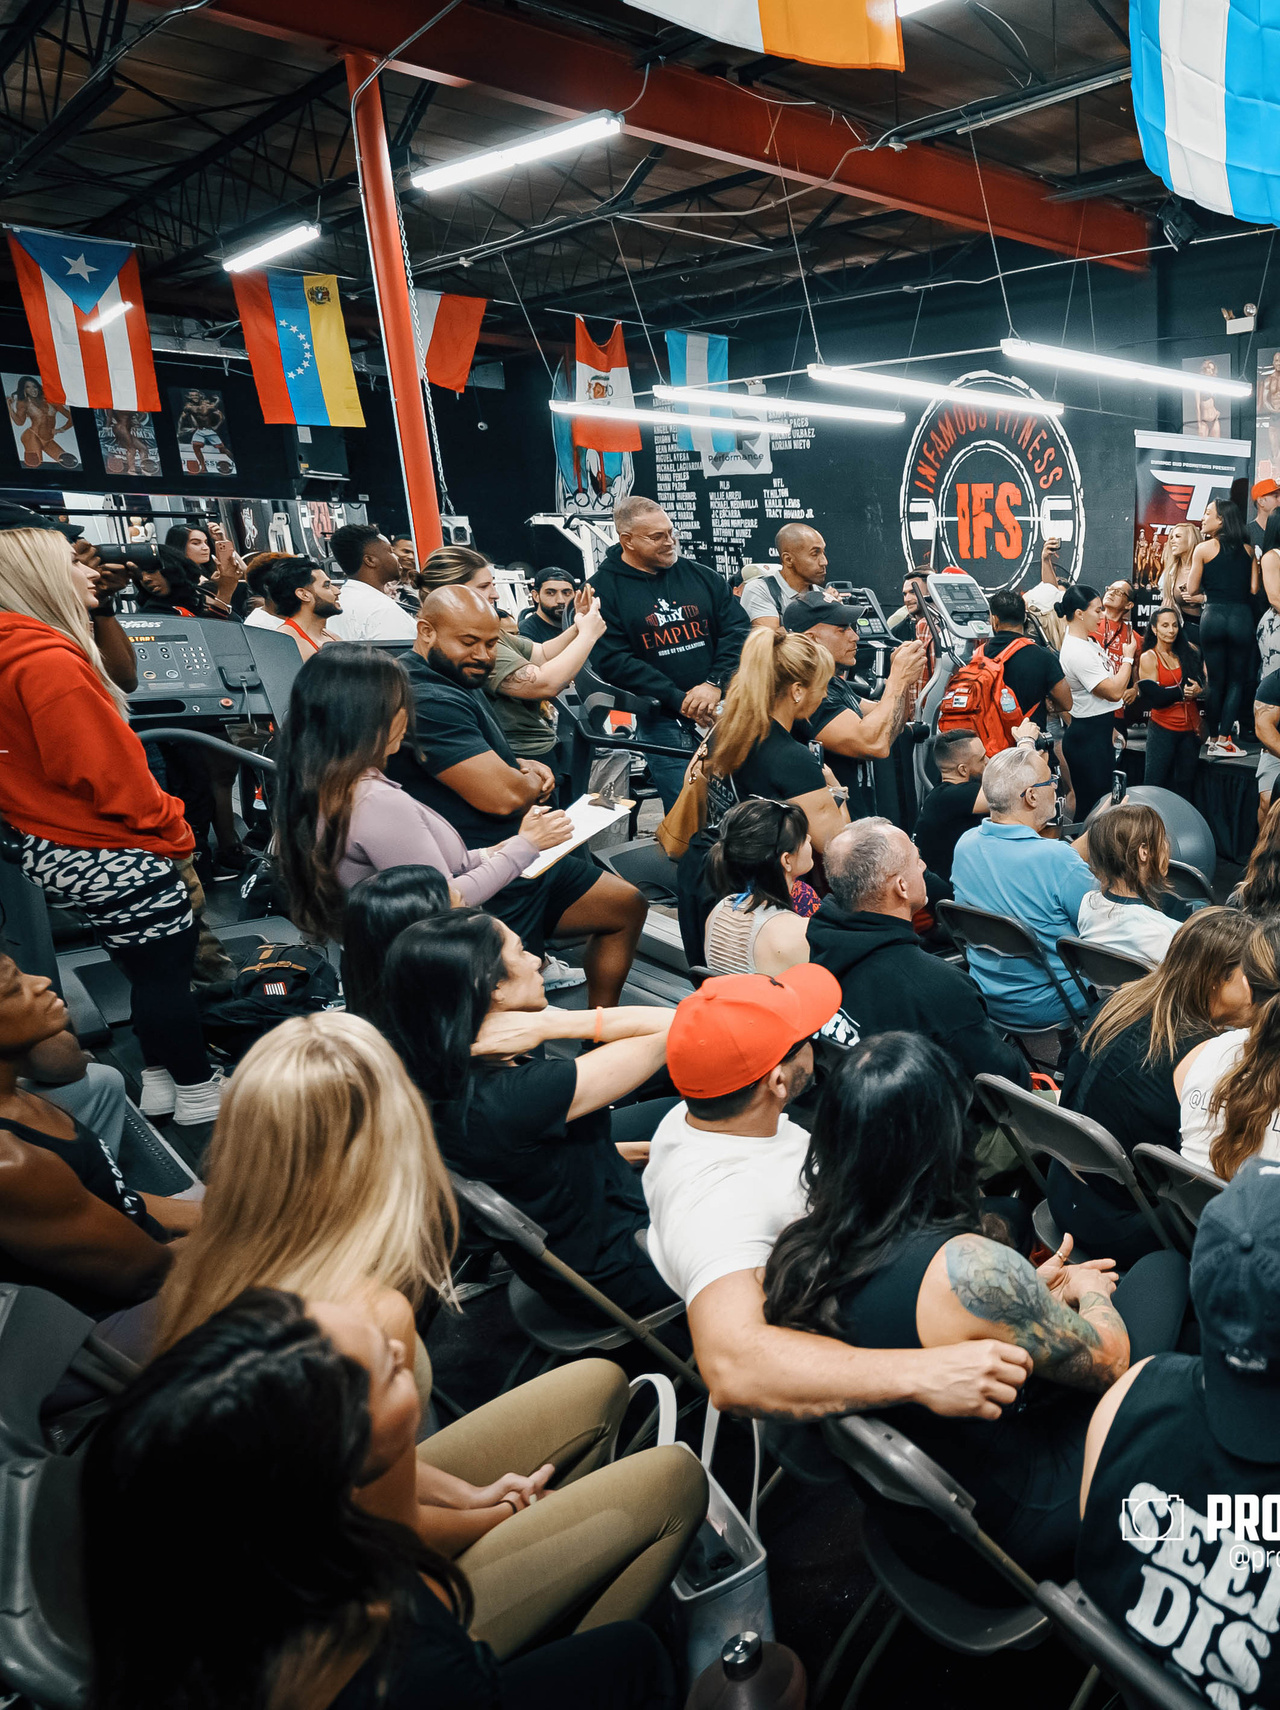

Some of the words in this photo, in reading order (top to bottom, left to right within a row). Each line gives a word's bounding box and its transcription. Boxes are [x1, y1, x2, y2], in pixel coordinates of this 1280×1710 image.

[708, 453, 764, 465] Performance
[956, 482, 1023, 559] IFS
[1126, 1564, 1271, 1694] DIS
